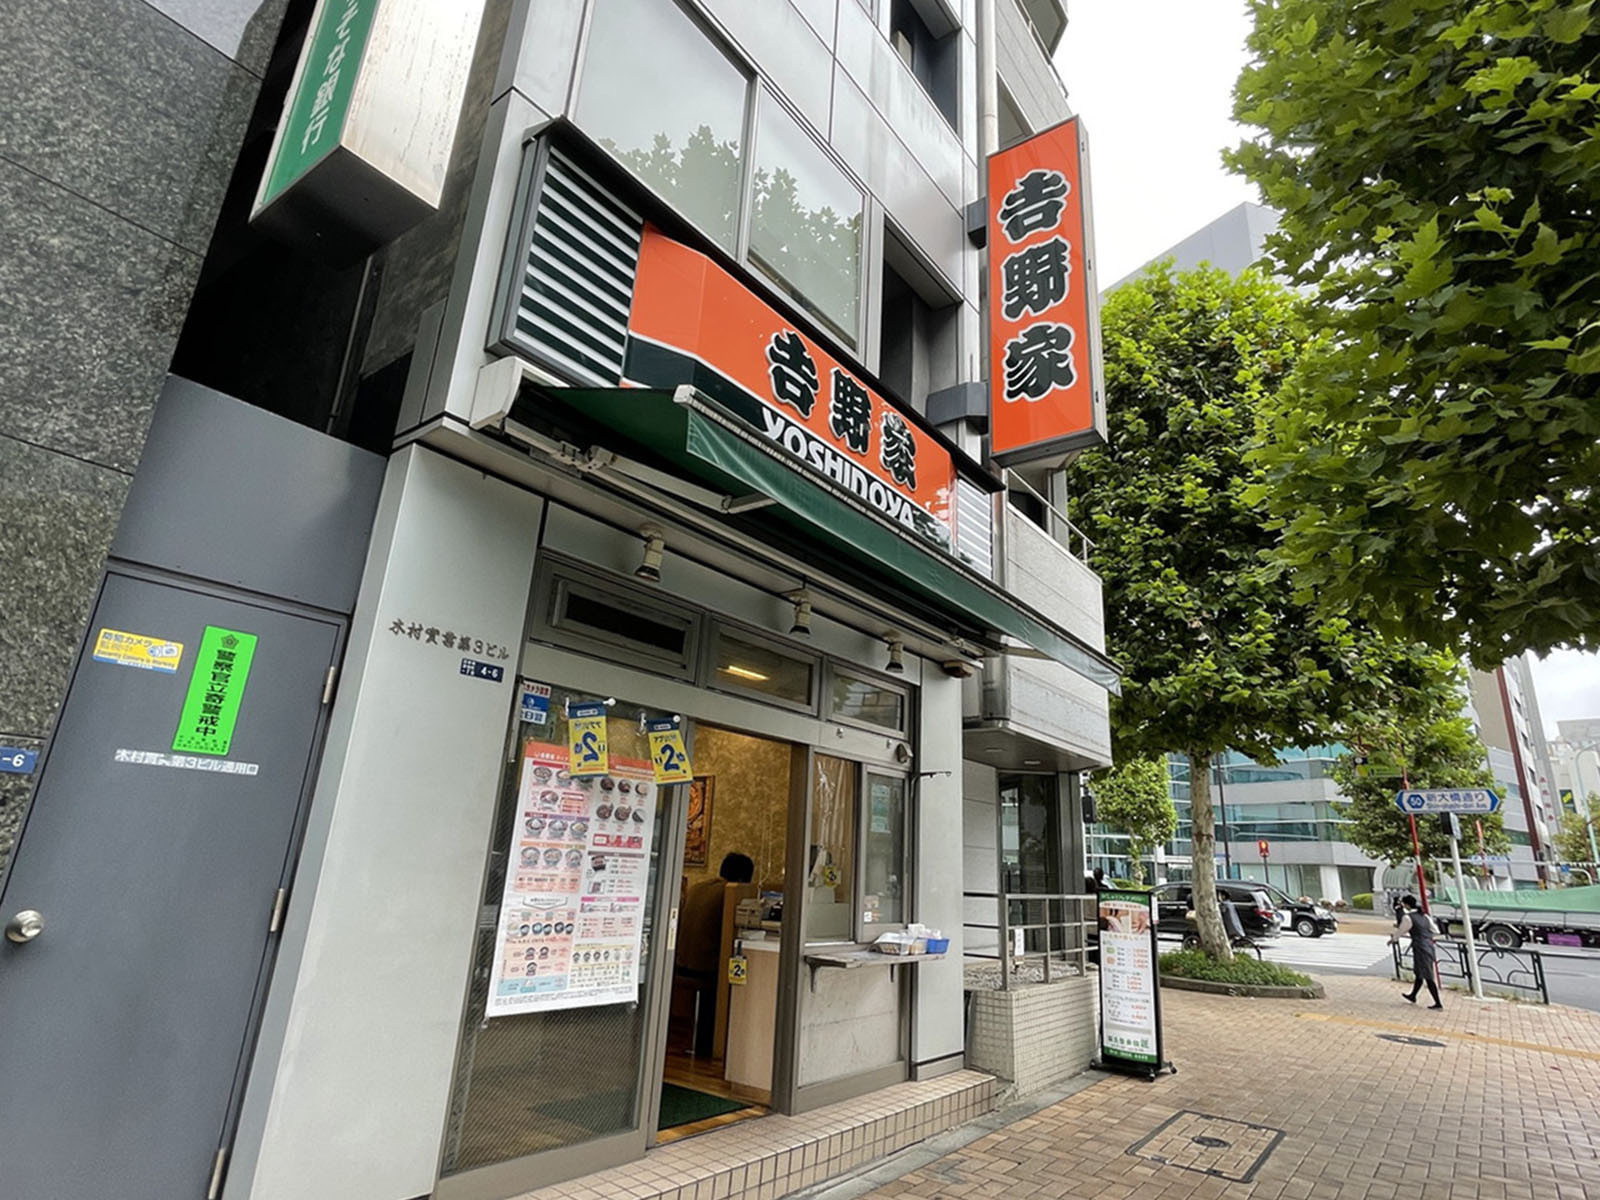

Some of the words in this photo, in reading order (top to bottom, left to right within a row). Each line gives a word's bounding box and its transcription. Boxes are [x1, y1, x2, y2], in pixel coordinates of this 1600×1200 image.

[998, 168, 1077, 402] 吉野家
[765, 328, 917, 492] 吉野家
[762, 406, 916, 530] YOSHINOYA
[196, 649, 236, 736] 警察官立寄警戒中
[480, 666, 499, 679] 4-6
[1426, 792, 1485, 803] 新大橋通り
